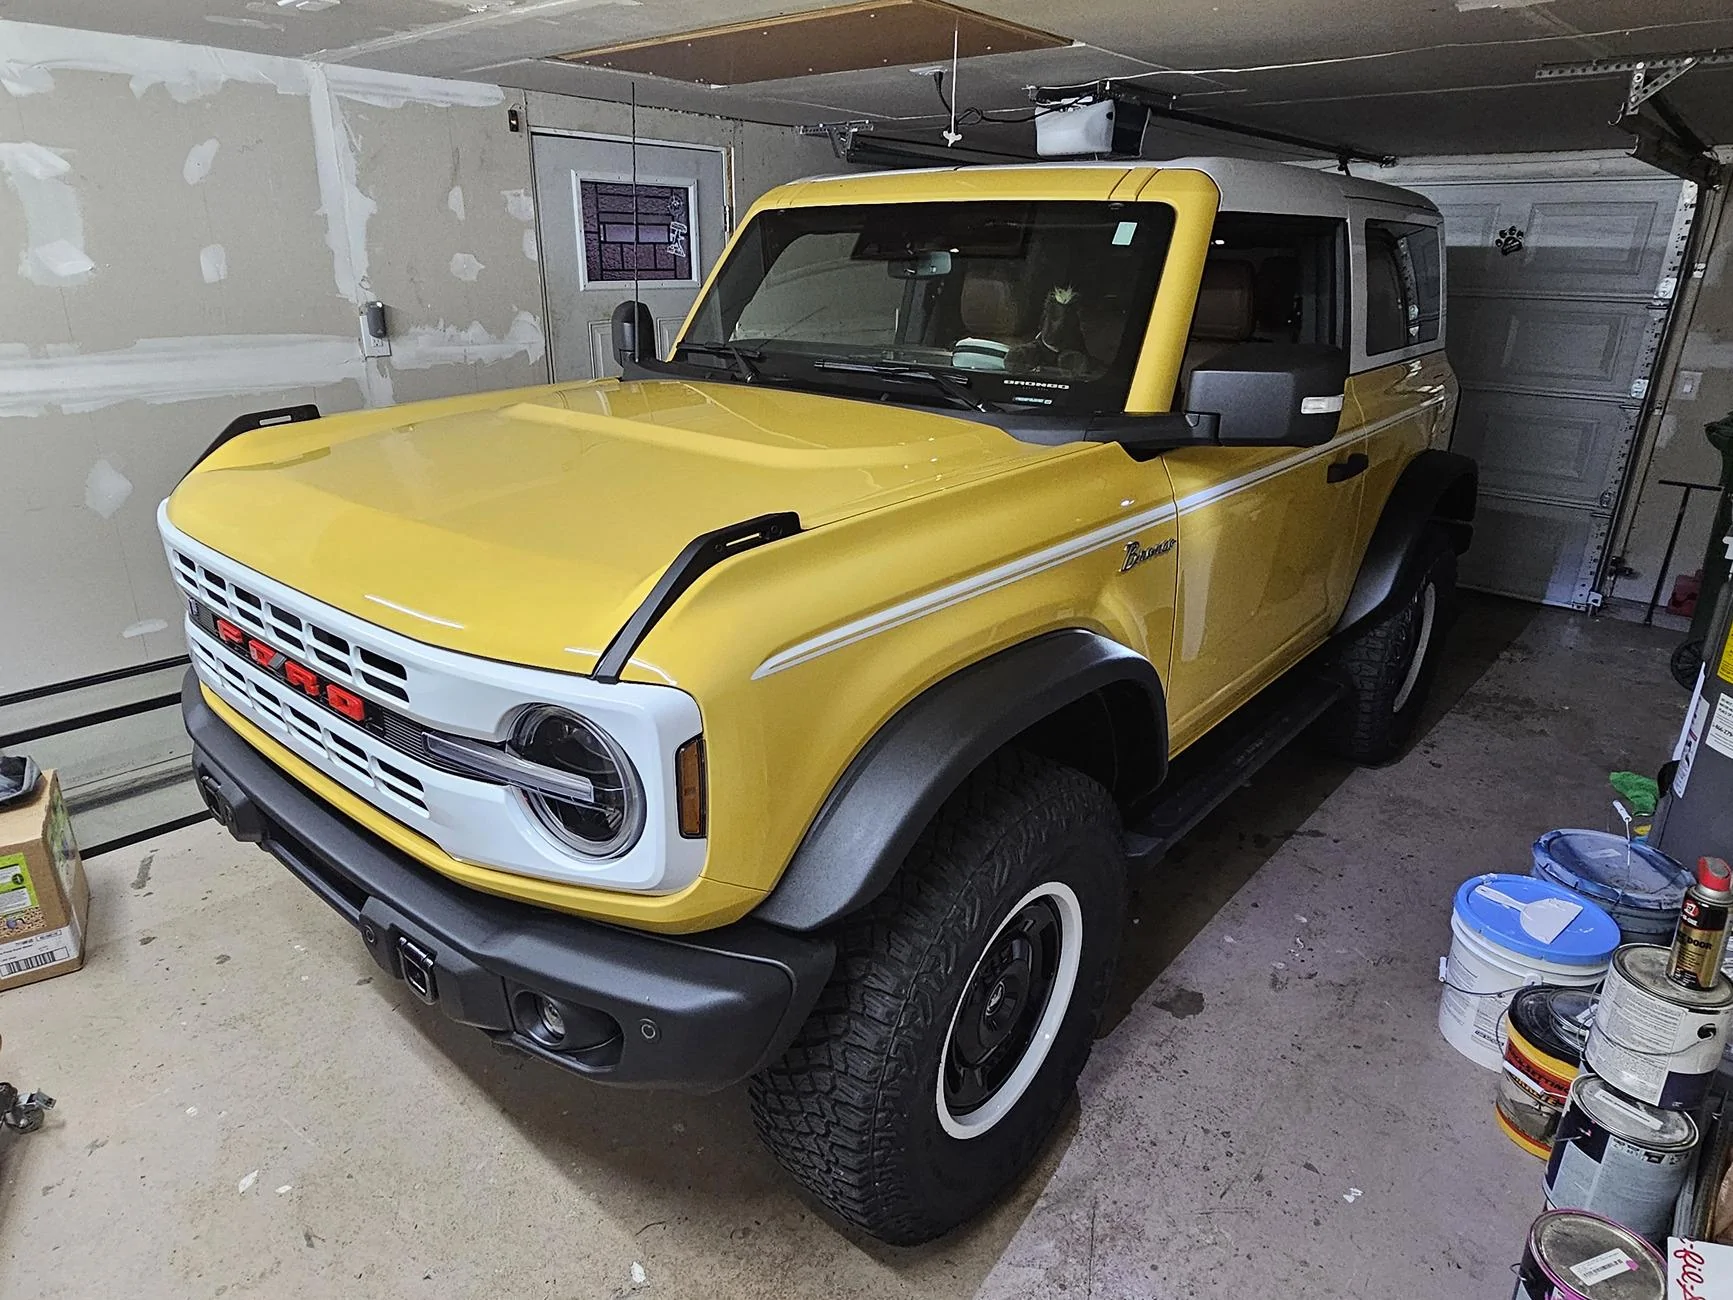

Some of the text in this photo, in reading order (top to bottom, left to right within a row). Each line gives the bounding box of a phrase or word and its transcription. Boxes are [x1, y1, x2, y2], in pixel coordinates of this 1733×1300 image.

[1003, 379, 1070, 390] BRONCO
[1119, 537, 1177, 573] Bronco
[216, 618, 366, 722] FORD
[1686, 936, 1713, 950] DOOR
[1673, 1236, 1706, 1300] -fil-
